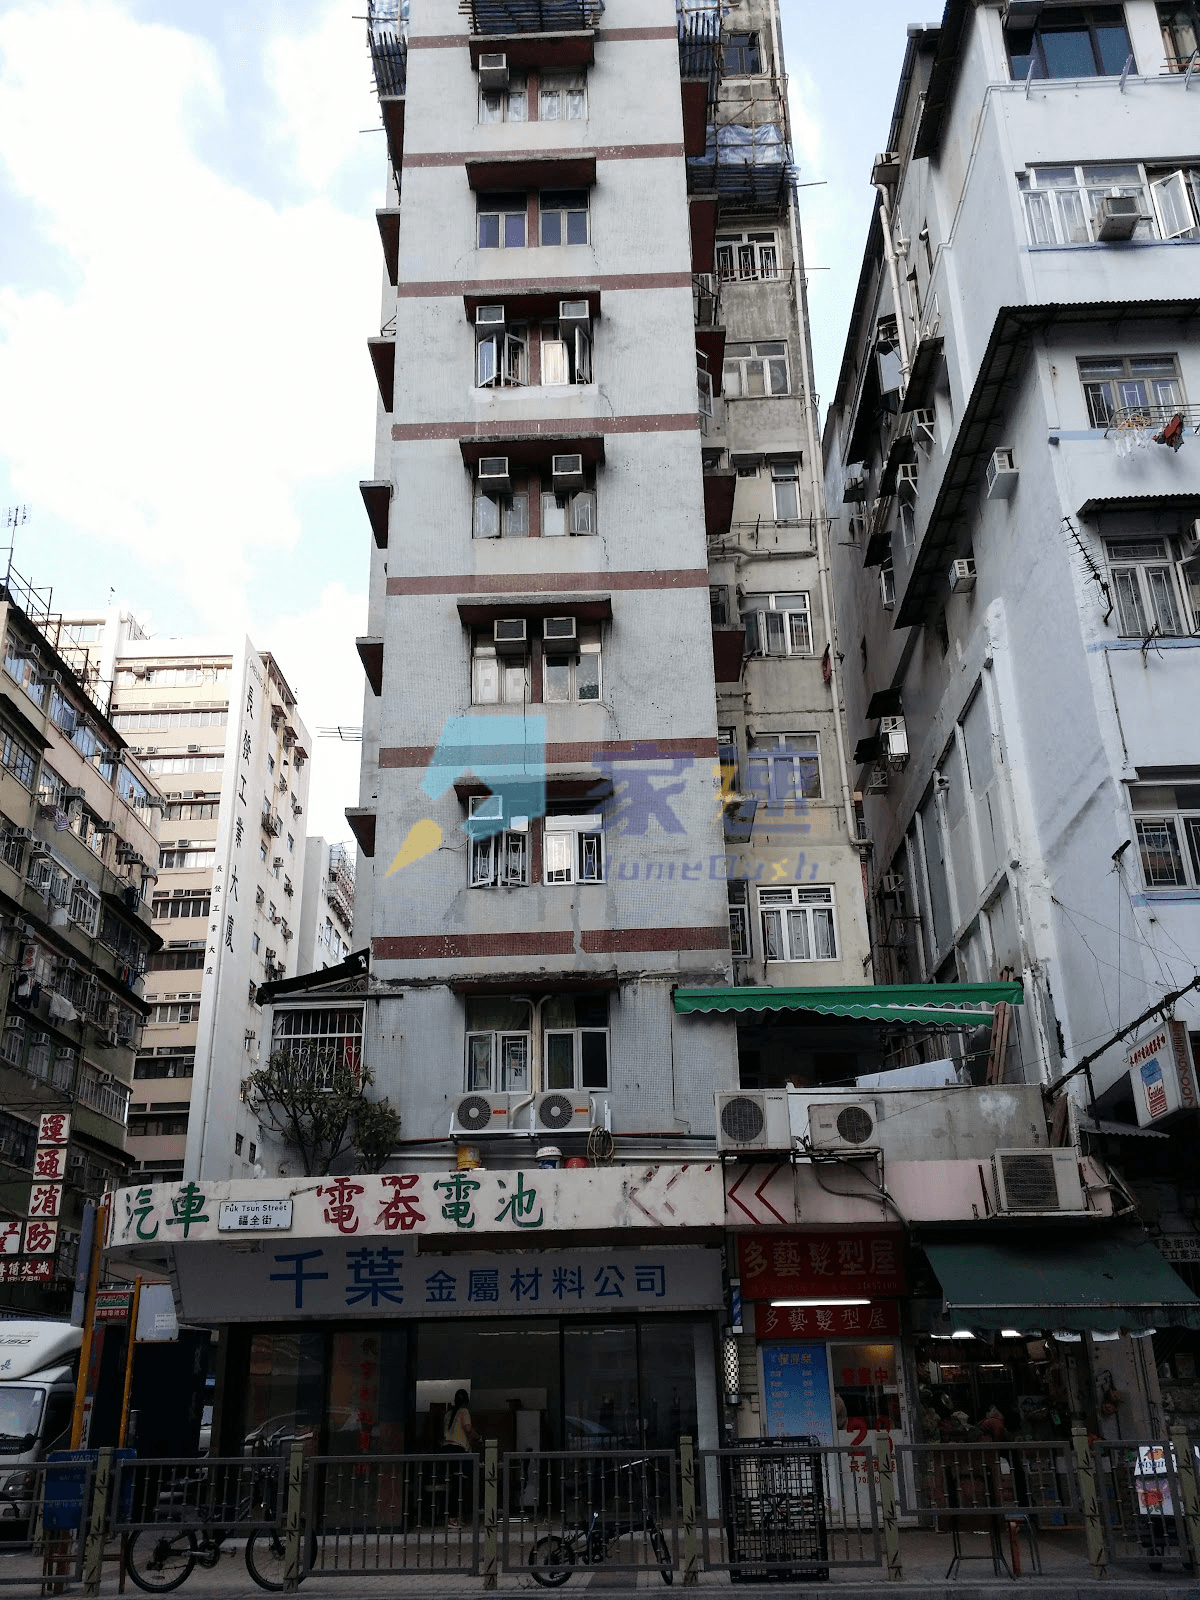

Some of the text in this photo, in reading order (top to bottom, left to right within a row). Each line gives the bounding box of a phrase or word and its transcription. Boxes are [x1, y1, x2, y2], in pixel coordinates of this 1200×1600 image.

[125, 1182, 209, 1240] 汽車
[316, 1170, 544, 1234] 電器電池
[239, 1215, 272, 1226] 福全街
[270, 1246, 668, 1309] 千葉金屬材料公司
[743, 1239, 897, 1279] 多藝髮型屋
[765, 1307, 888, 1333] 多藝髮型屋
